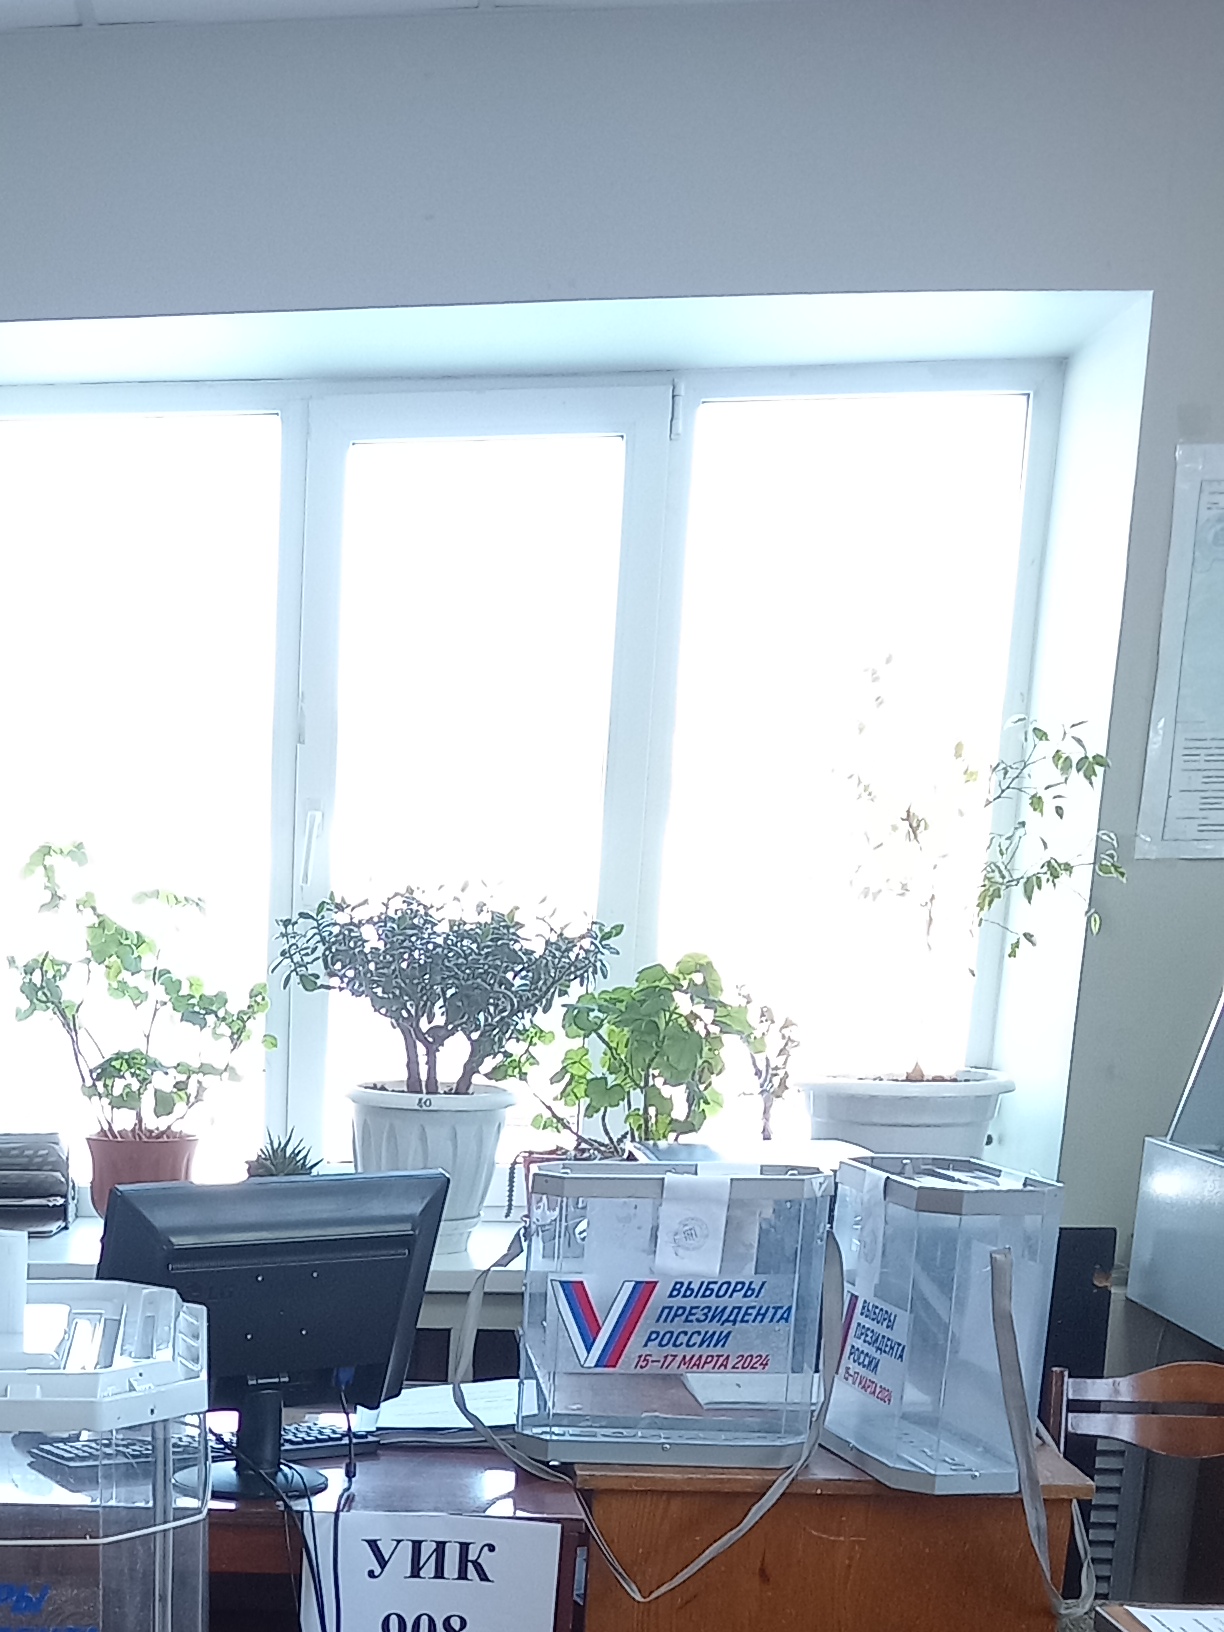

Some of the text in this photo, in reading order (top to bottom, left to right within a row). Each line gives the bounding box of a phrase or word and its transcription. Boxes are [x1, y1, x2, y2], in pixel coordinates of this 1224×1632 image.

[667, 1280, 767, 1299] ВЫБОРЫ
[655, 1305, 793, 1327] ПРЕЗИДЕНТА
[860, 1299, 897, 1332] ВЫБОРЫ
[642, 1330, 733, 1349] РОССИИ
[853, 1321, 907, 1363] ПРЕЗИДЕНТА
[676, 1354, 730, 1370] МАРТА
[731, 1353, 771, 1371] 2024
[847, 1344, 881, 1376] РОССИИ
[857, 1373, 877, 1398] МАРТА
[876, 1384, 893, 1406] 2024
[361, 1538, 496, 1584] УИК
